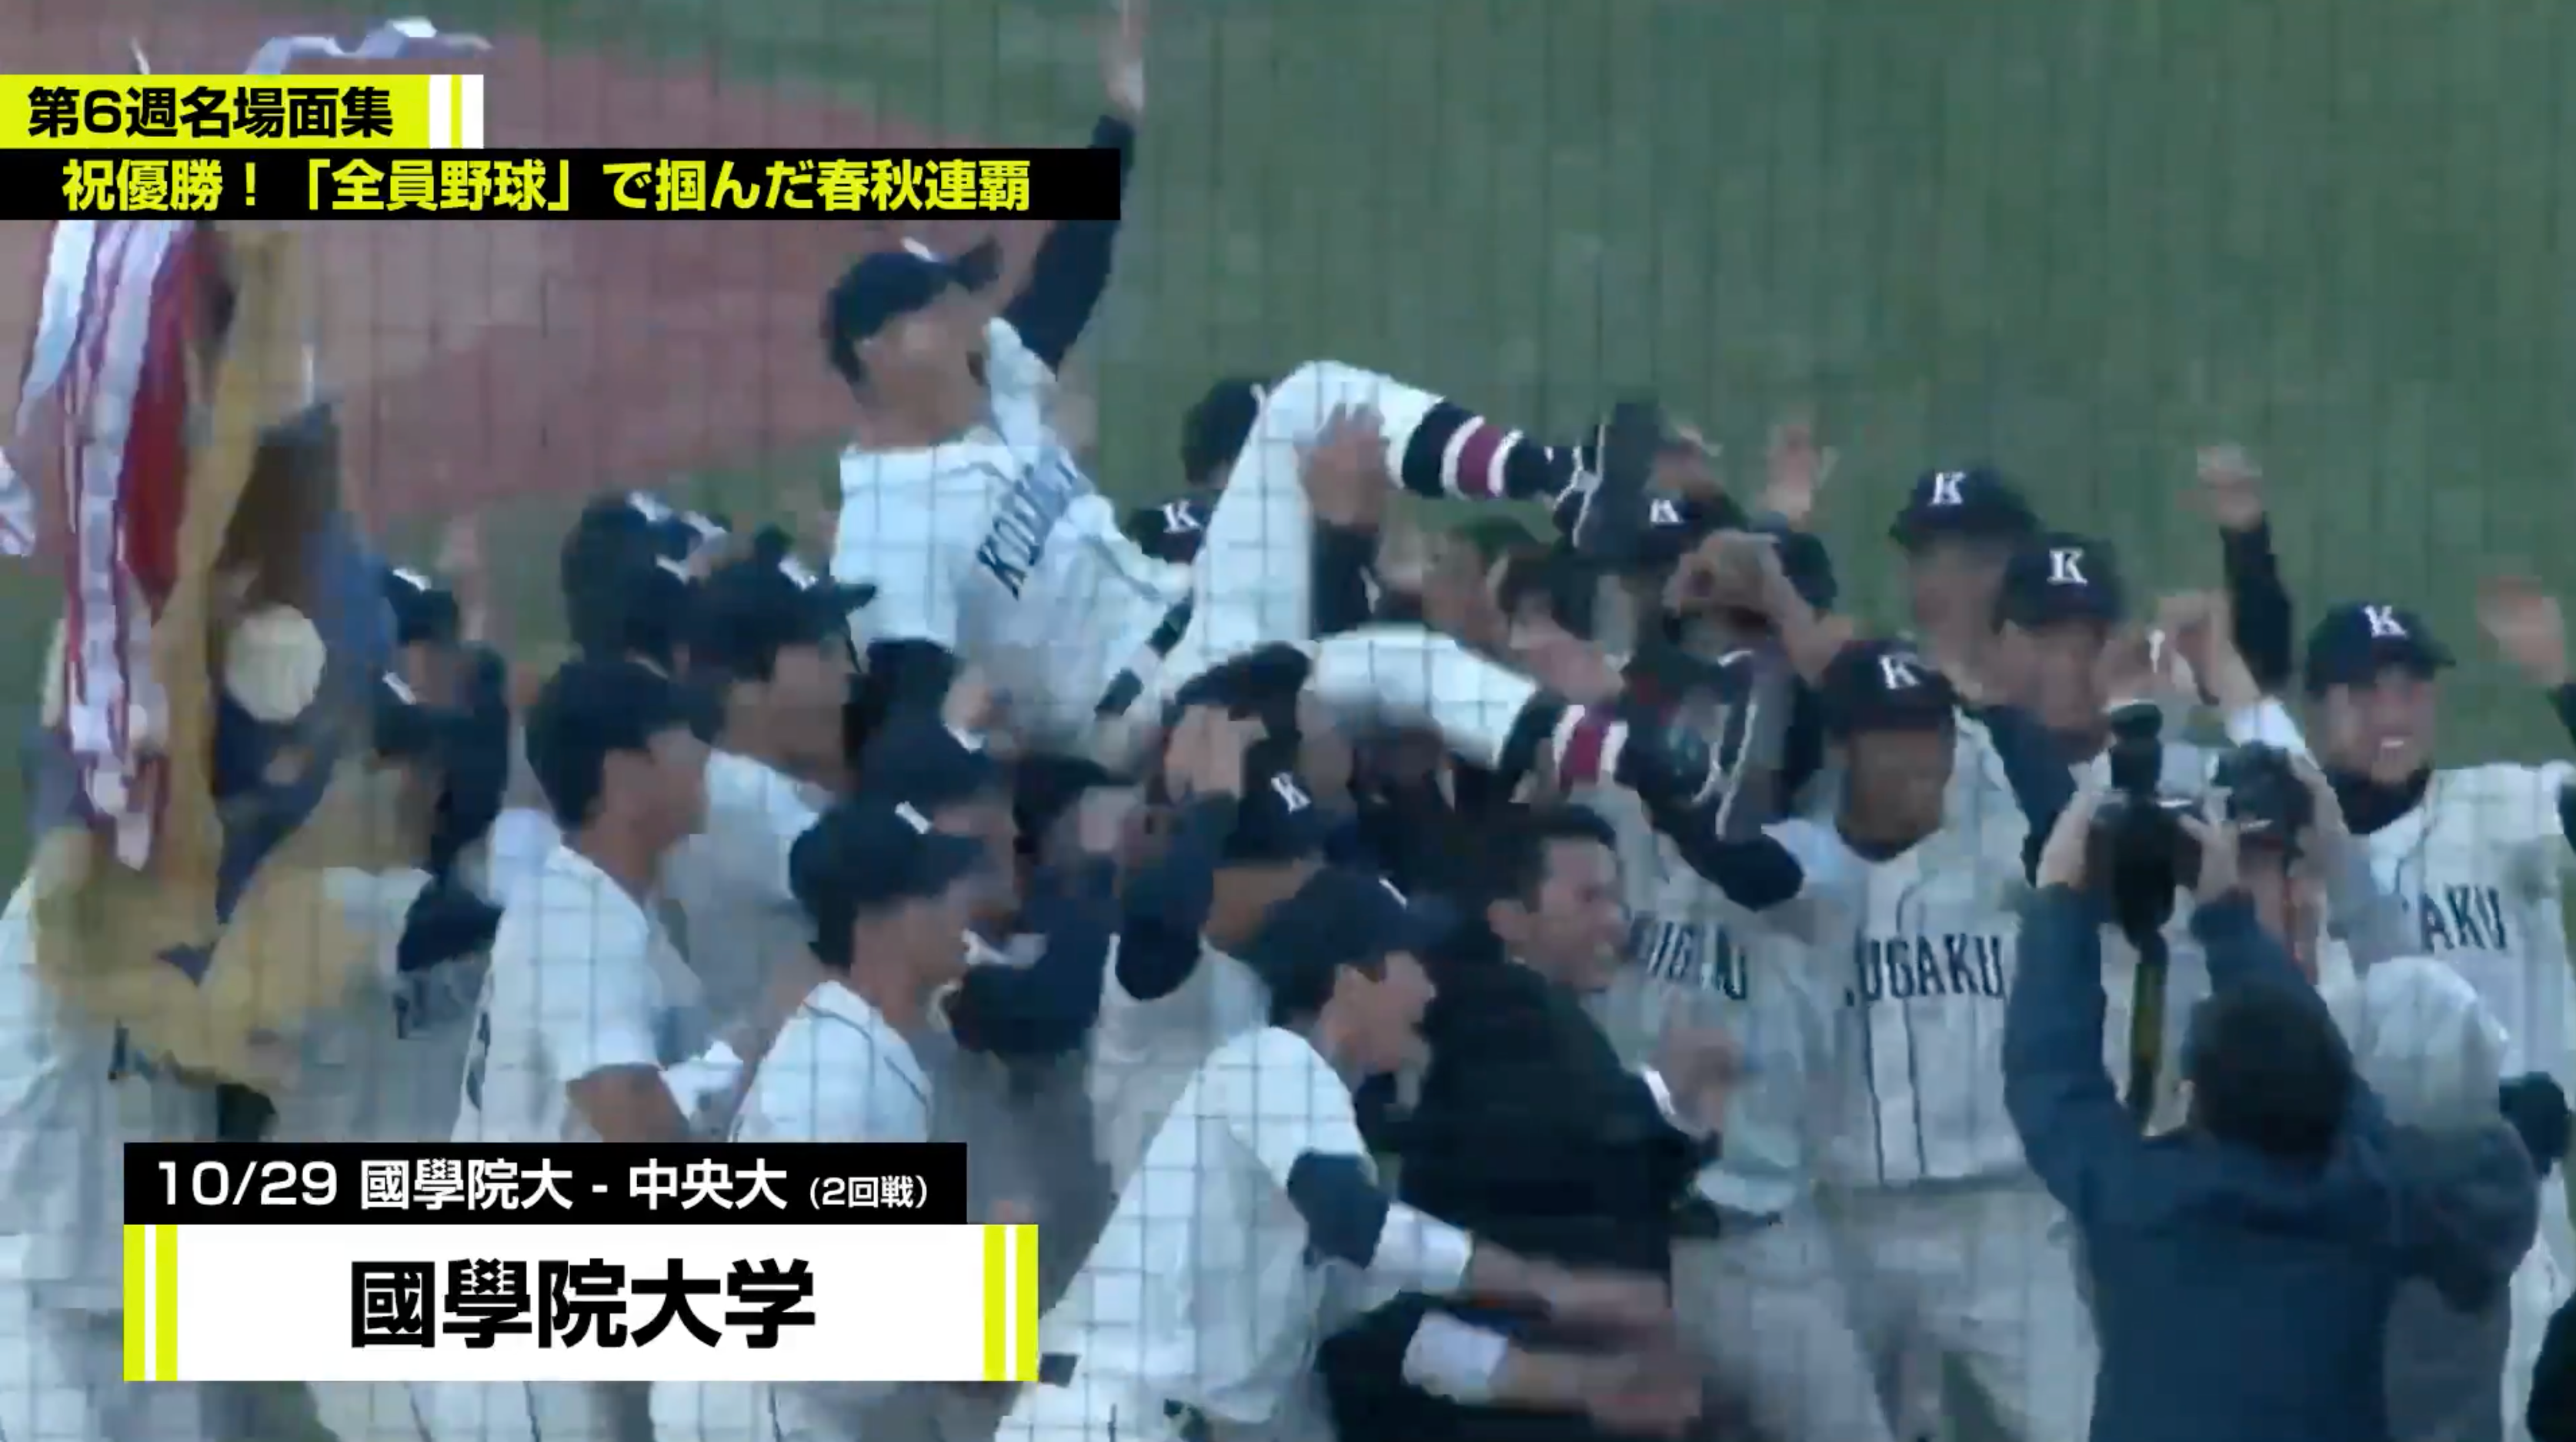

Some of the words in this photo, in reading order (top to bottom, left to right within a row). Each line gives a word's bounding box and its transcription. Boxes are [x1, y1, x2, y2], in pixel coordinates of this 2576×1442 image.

[1930, 469, 1967, 506] K
[1163, 500, 1201, 533] K
[2049, 549, 2088, 586] K
[2363, 604, 2407, 638] K
[1879, 653, 1919, 690] K
